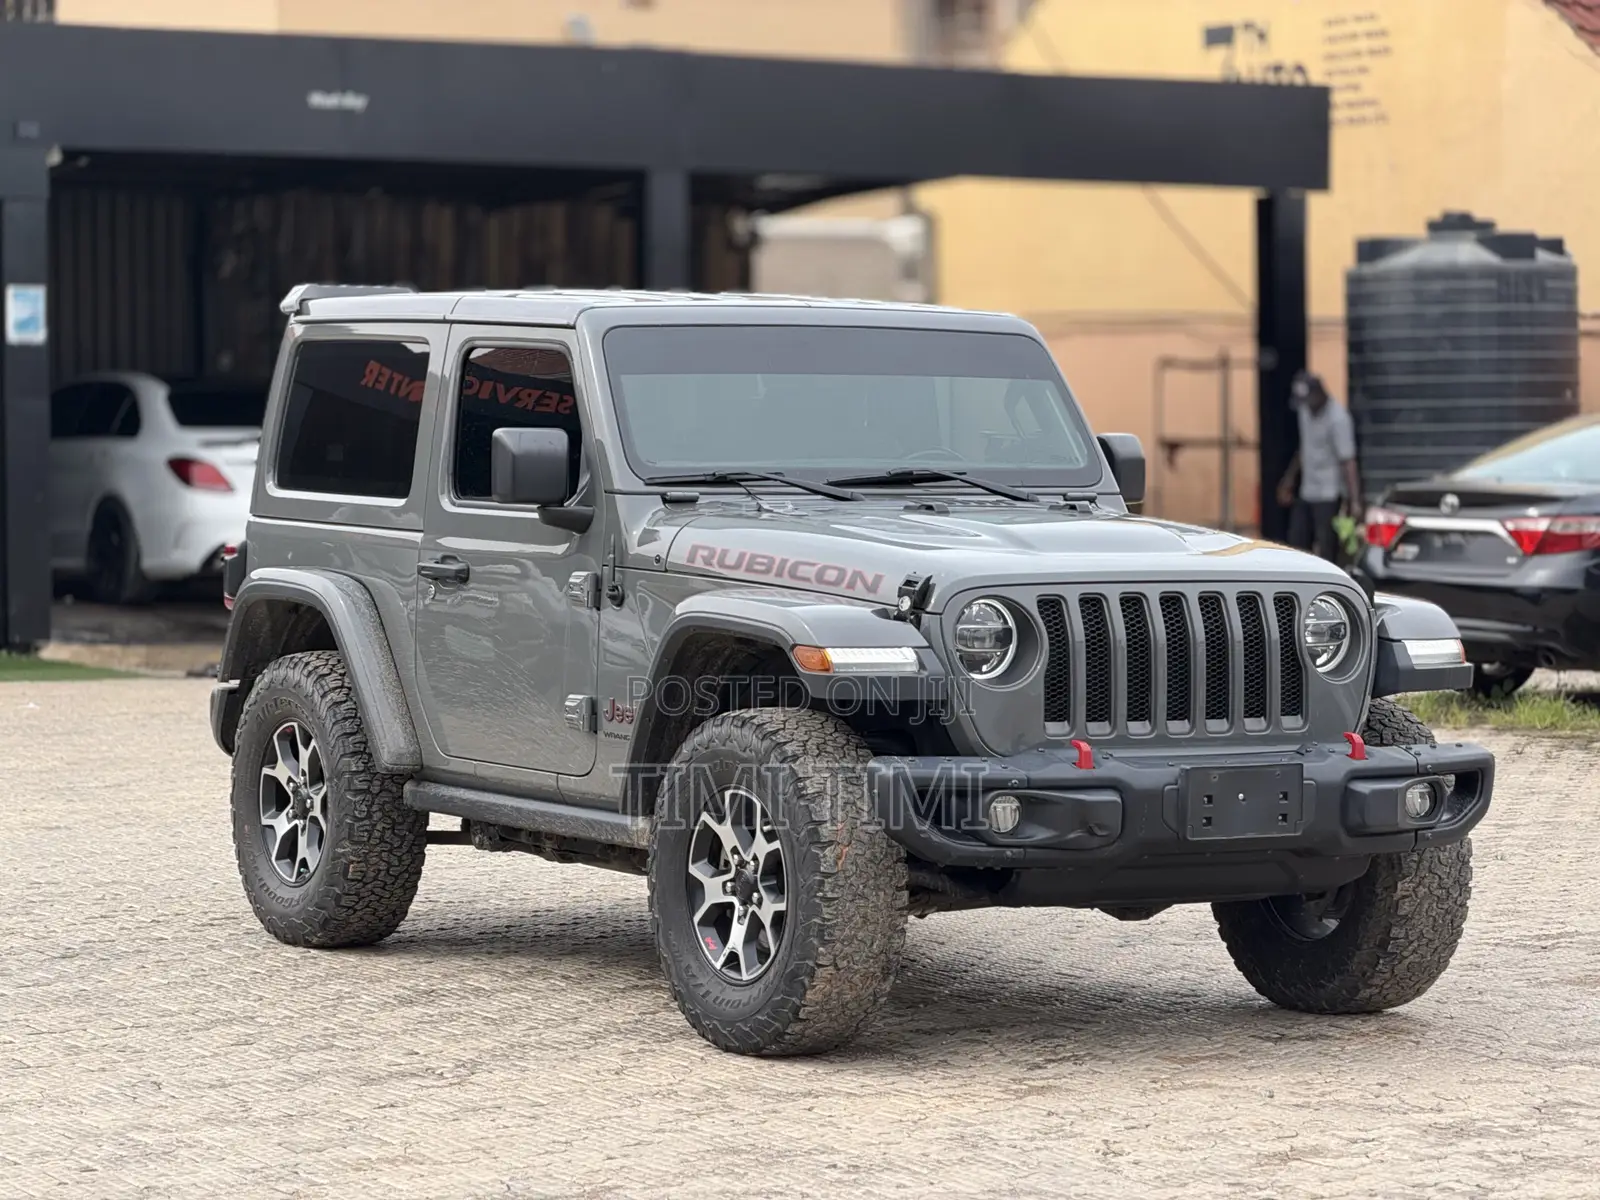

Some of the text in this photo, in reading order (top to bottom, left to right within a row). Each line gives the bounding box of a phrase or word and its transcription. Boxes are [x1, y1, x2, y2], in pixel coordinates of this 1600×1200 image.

[684, 543, 886, 595] RUBICON
[602, 696, 636, 725] Jee
[603, 731, 631, 741] WRANG
